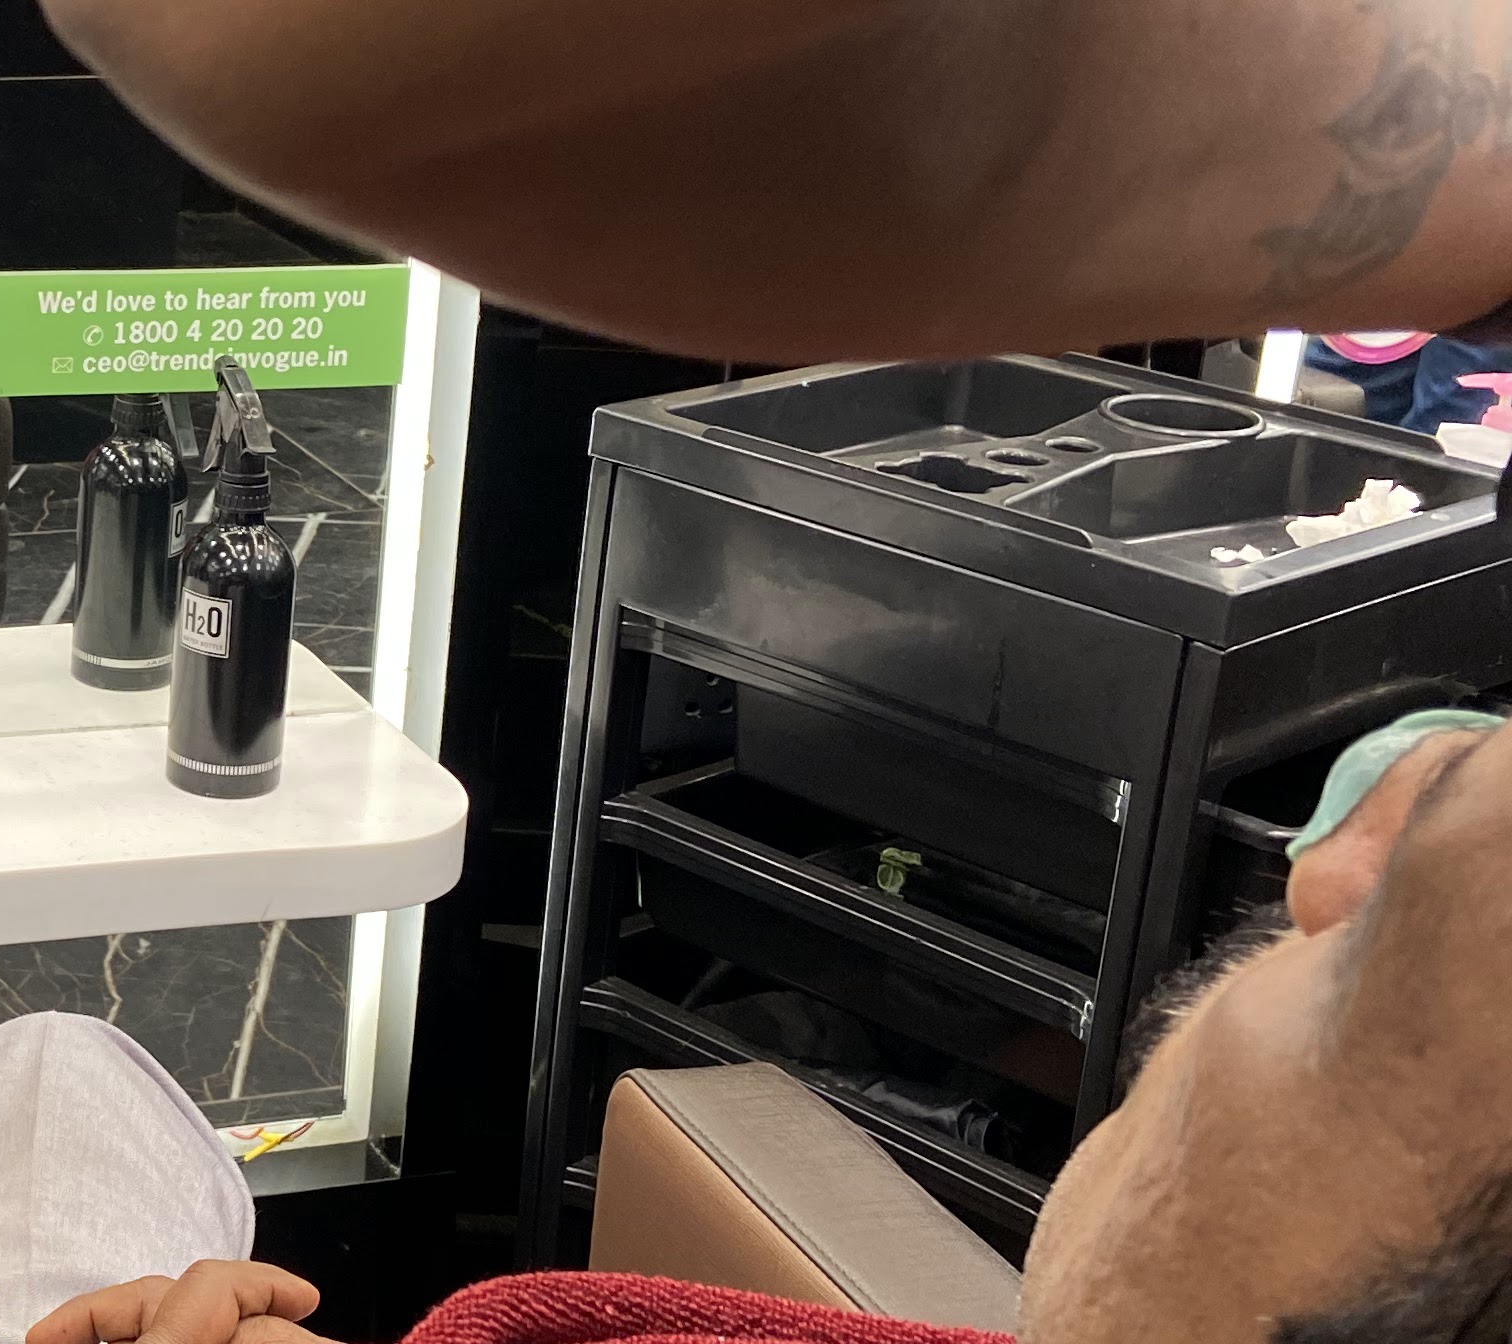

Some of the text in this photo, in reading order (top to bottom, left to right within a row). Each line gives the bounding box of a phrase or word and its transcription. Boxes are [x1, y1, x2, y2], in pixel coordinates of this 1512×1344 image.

[38, 286, 367, 314] We'd love to hear from you
[113, 316, 324, 345] 1800 4 20 20 20
[82, 344, 348, 374] ceo@trendnvogue.in
[184, 598, 223, 638] H2O
